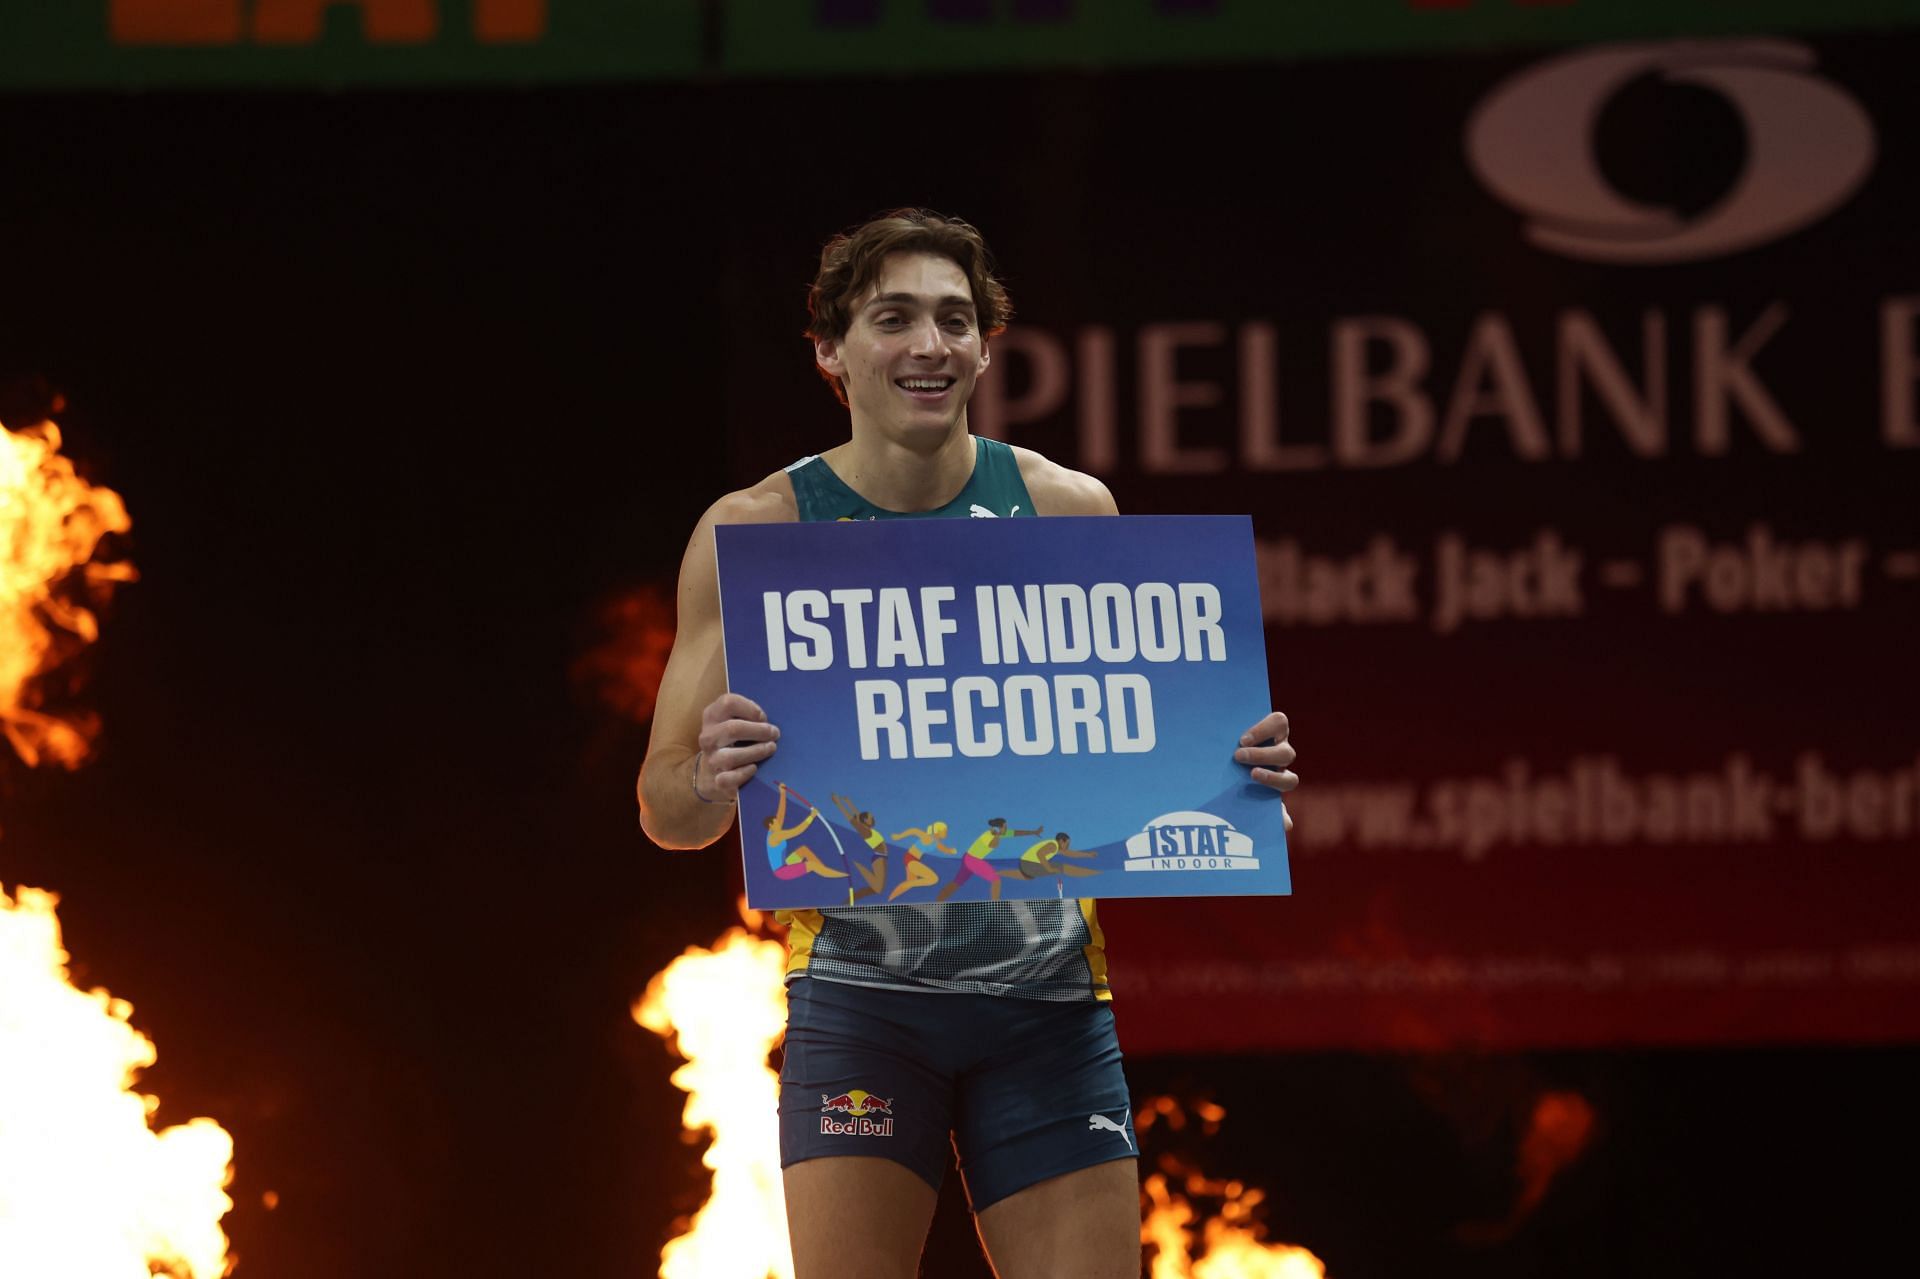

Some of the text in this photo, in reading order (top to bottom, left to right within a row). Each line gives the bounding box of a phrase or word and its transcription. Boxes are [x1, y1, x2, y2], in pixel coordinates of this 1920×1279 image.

[972, 299, 1804, 475] PIELBANK
[1430, 528, 1584, 634] Jack
[1656, 524, 1868, 613] Poker
[763, 582, 1227, 672] ISTAF INDOOR
[854, 673, 1157, 761] RECORD
[1148, 824, 1230, 857] ISTAF
[1287, 748, 1920, 862] ww.spielbank-ber
[1151, 858, 1232, 870] INDOOR
[820, 1116, 893, 1136] Red Bull
